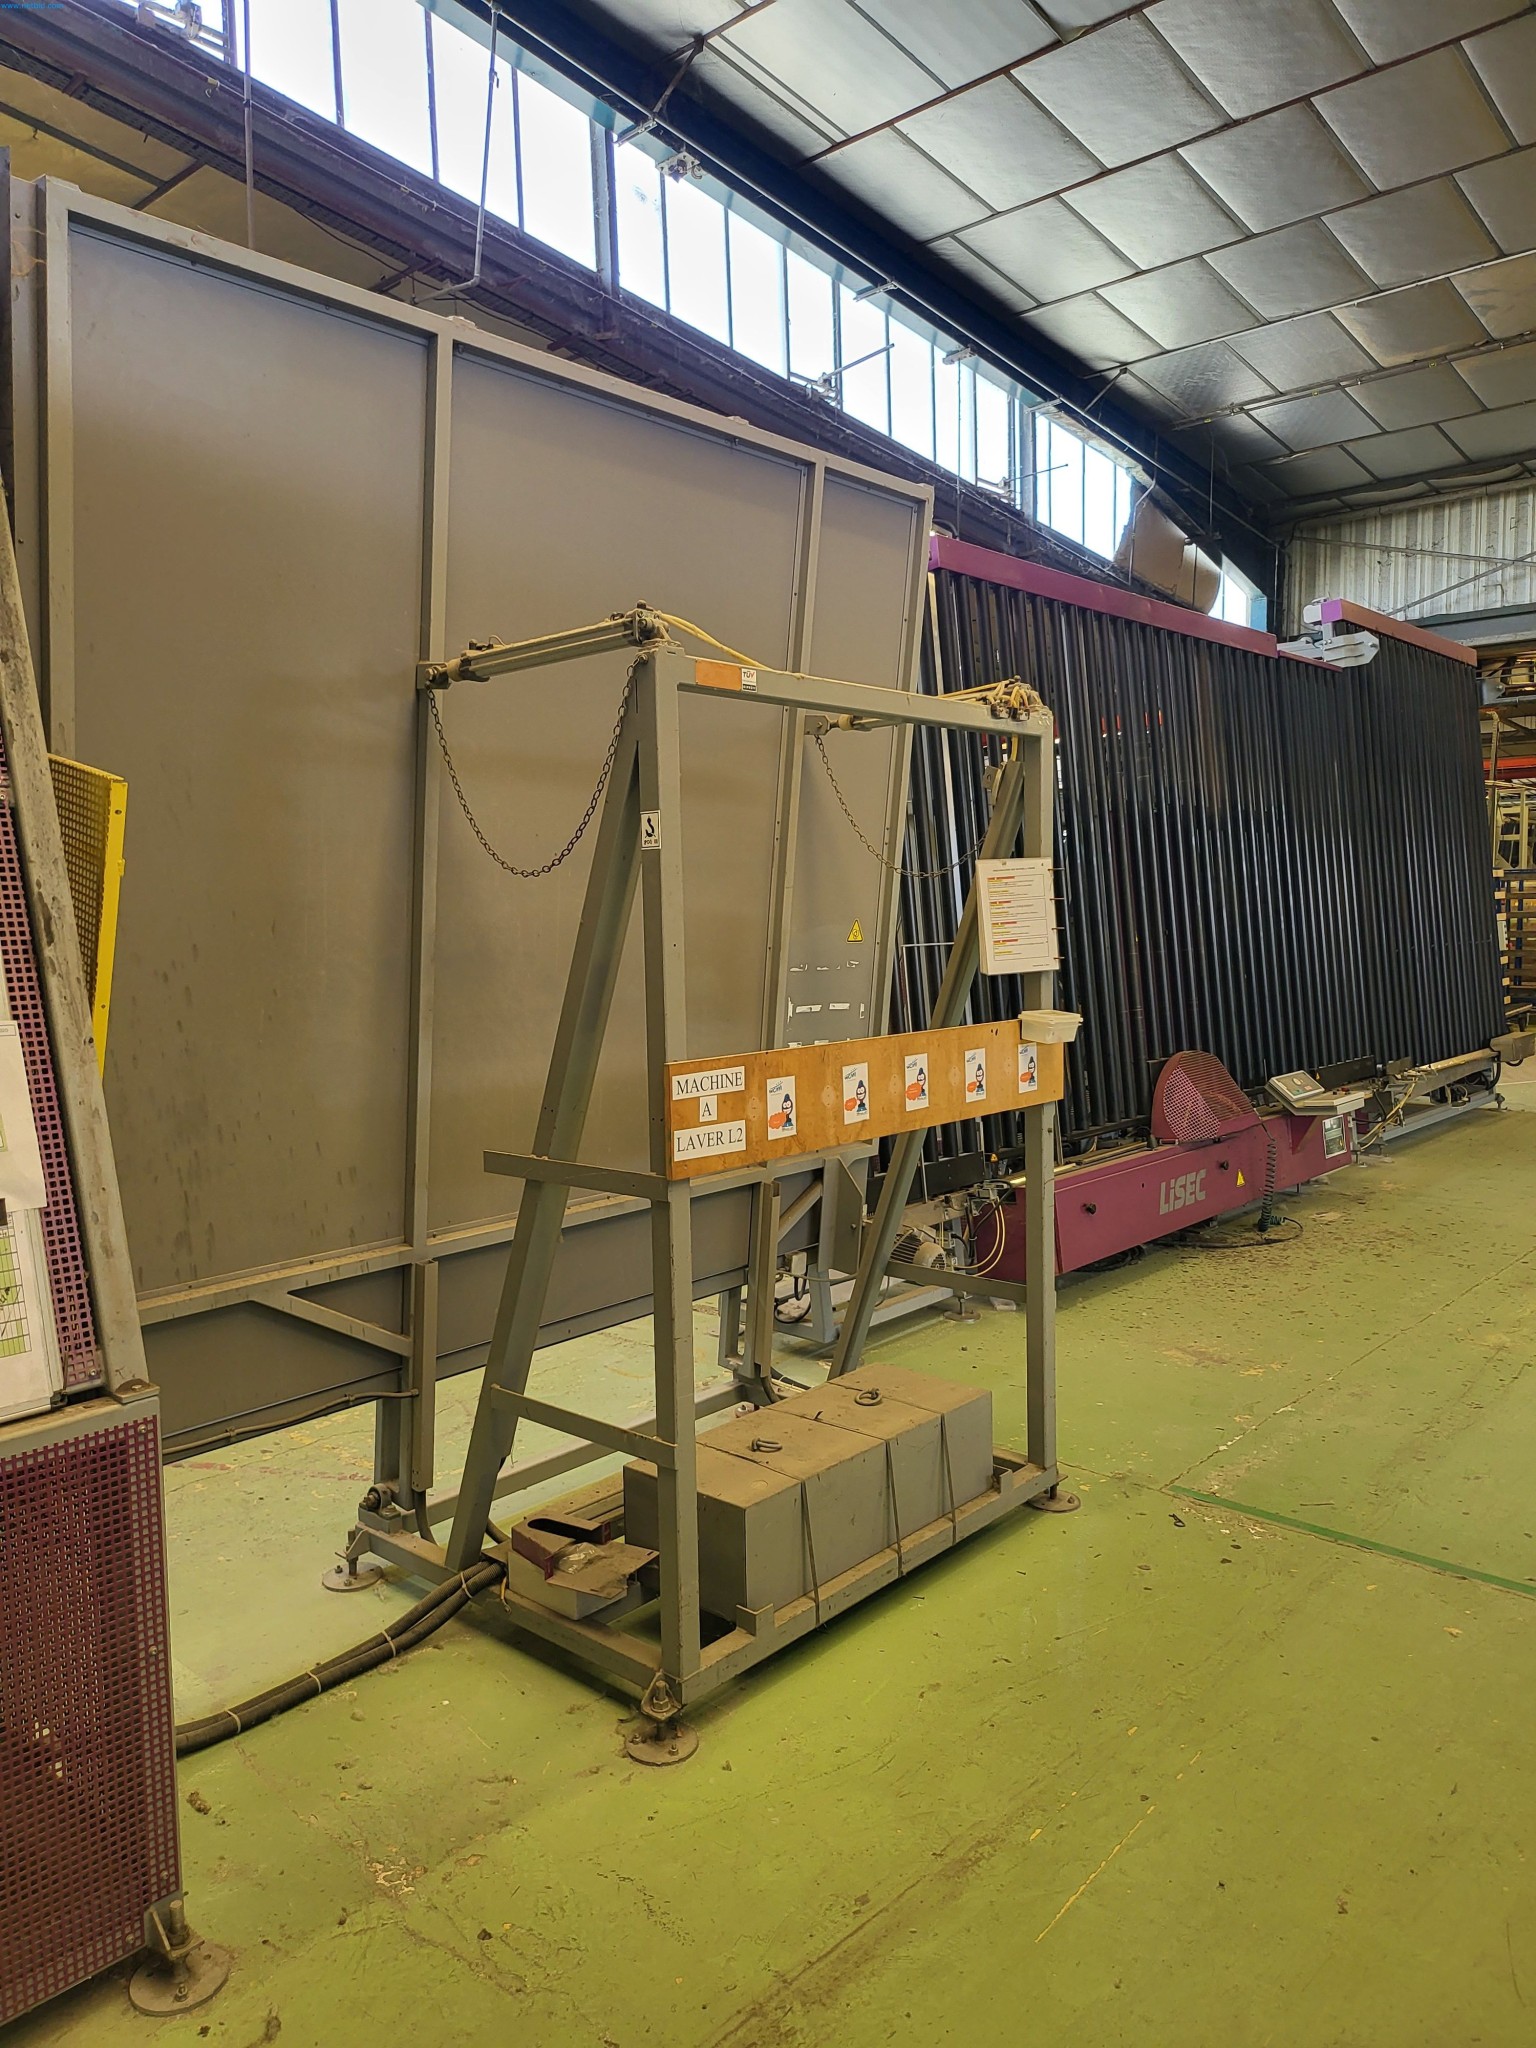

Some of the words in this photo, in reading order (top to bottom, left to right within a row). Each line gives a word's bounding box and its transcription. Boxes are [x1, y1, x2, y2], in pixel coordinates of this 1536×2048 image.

[742, 670, 755, 678] TÜV
[676, 1072, 743, 1095] MACHINE
[701, 1102, 712, 1117] A
[676, 1131, 726, 1153] LAVER
[728, 1127, 743, 1144] L2
